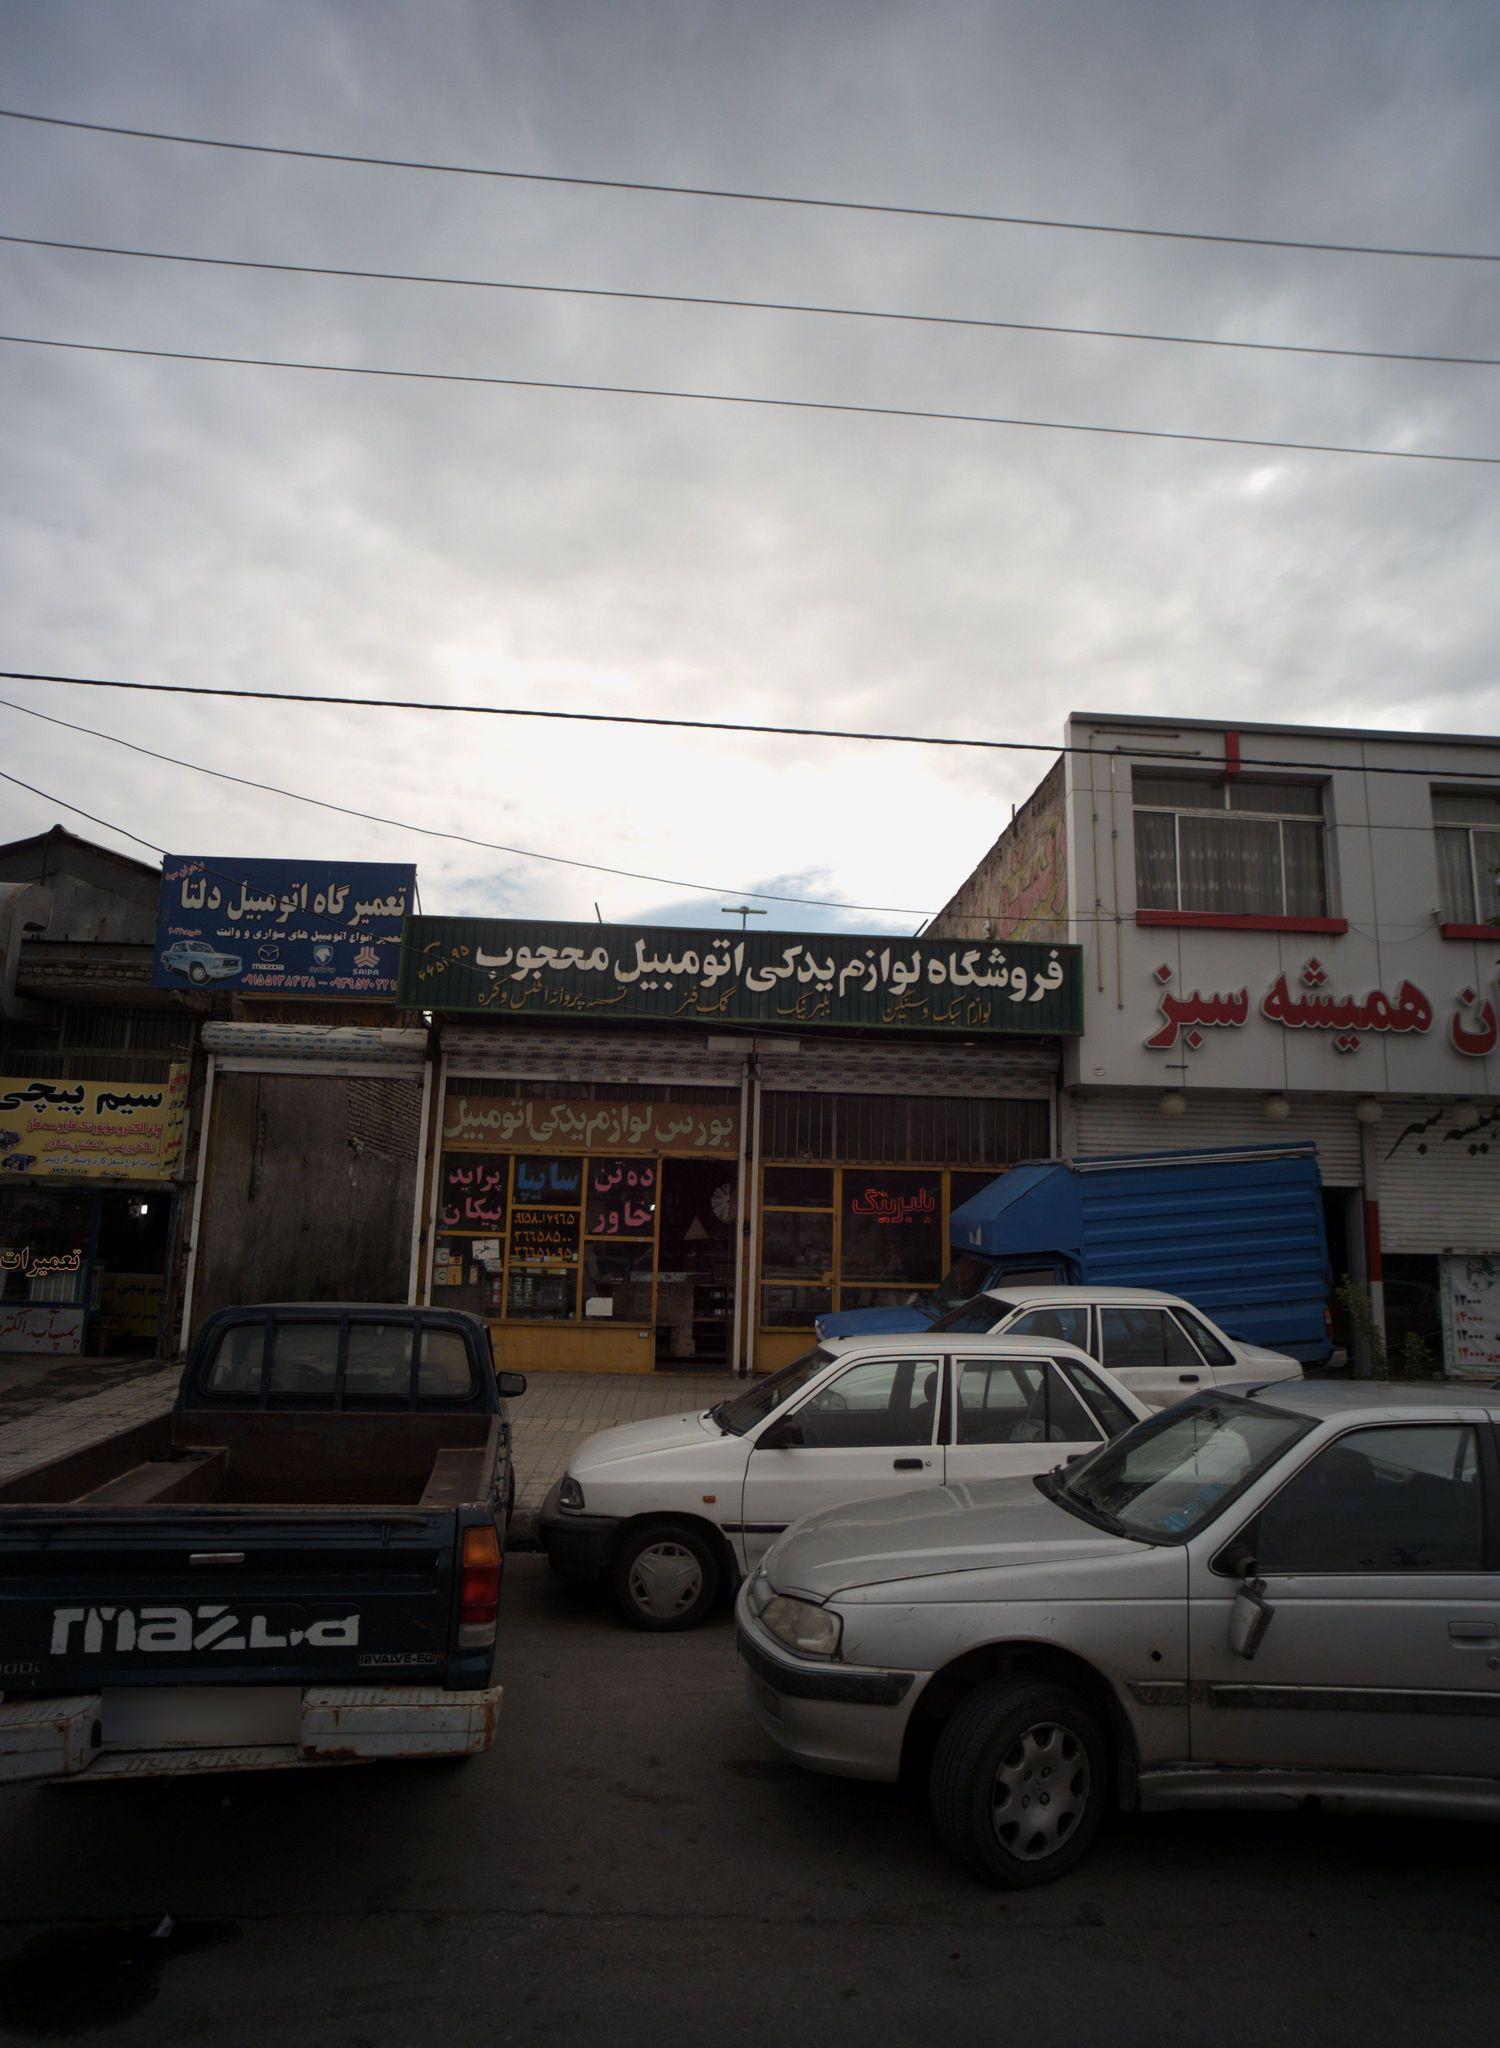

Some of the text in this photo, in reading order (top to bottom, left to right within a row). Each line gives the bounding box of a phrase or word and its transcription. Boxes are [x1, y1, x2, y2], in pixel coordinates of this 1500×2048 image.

[181, 877, 221, 910] دلتا
[227, 880, 308, 923] اتومبیل
[253, 928, 285, 940] سواری
[288, 930, 308, 941] های
[311, 930, 347, 942] اتومبیل
[475, 938, 1064, 1002] فروشگاه لوازم یدکی اتومبیل محجوب
[1145, 956, 1433, 1053] همیشه سبز
[0, 1082, 163, 1116] سیم پیچی
[443, 1099, 734, 1147] بورس لوازم یدکی اتومبیل
[448, 1165, 502, 1193] پراید
[517, 1161, 579, 1201] سایپا
[593, 1162, 623, 1193] تن
[443, 1196, 502, 1231] پیکان
[592, 1200, 653, 1234] خاور
[851, 1186, 936, 1224] بلبرینگ
[0, 1246, 82, 1278] تعمیرات
[48, 1323, 81, 1351] پمپ
